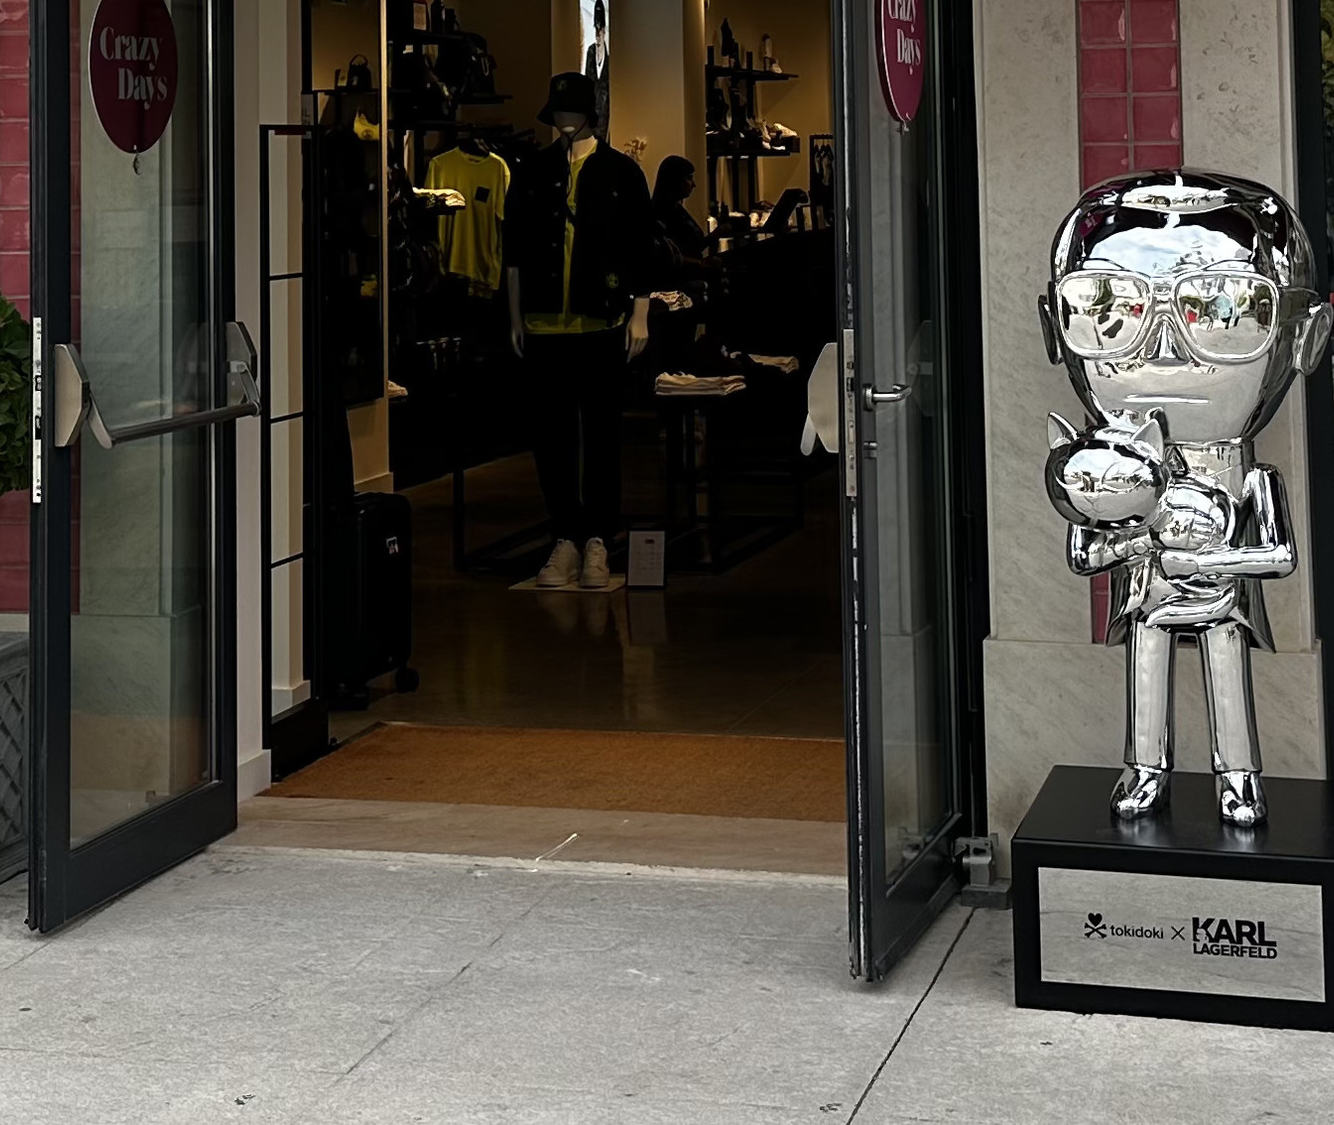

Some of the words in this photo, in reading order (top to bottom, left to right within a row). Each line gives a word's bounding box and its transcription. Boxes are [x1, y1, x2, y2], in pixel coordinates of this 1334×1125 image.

[100, 27, 163, 71] Crazy
[896, 28, 921, 75] Days
[118, 67, 168, 110] Days
[1110, 925, 1164, 940] tokidoki
[1192, 916, 1277, 947] KARL
[1193, 942, 1278, 960] LAGERFELD
